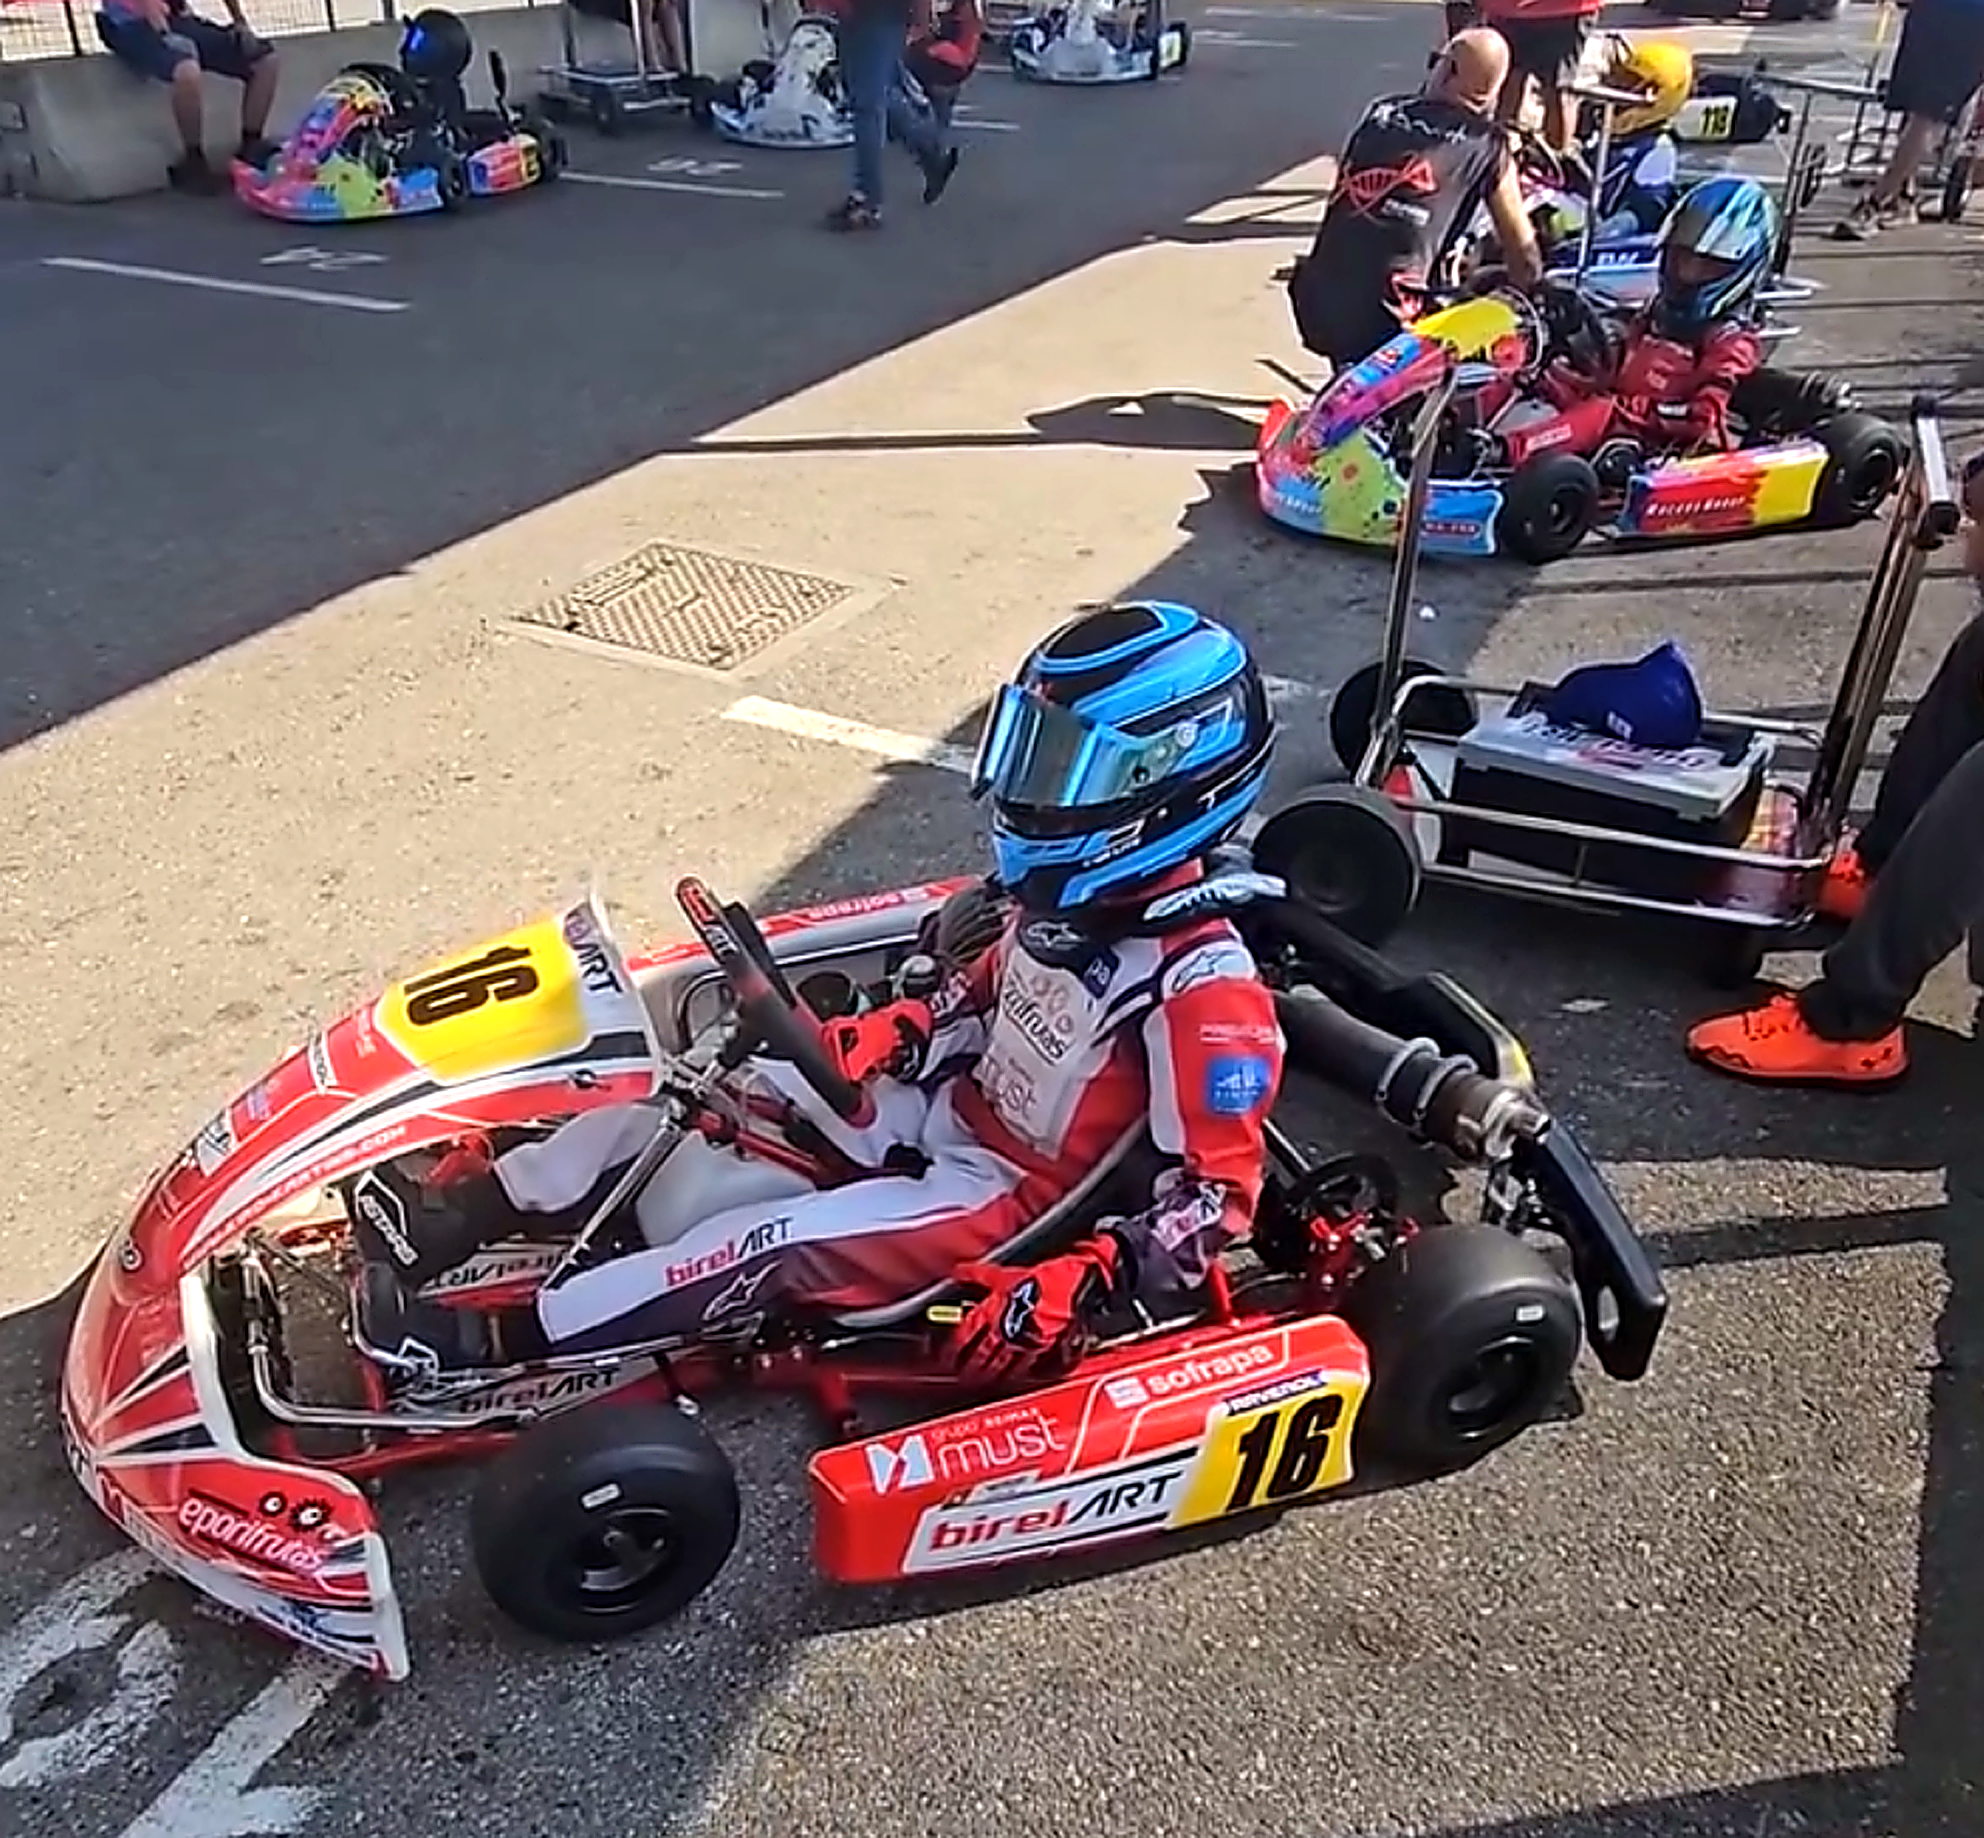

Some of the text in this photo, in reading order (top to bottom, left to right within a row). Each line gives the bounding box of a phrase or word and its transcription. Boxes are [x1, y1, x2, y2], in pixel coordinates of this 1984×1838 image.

[402, 944, 541, 1026] 16
[1146, 1345, 1274, 1395] sofrapa
[937, 1415, 1066, 1480] must
[1226, 1393, 1344, 1511] 16
[929, 1471, 1183, 1550] birelART
